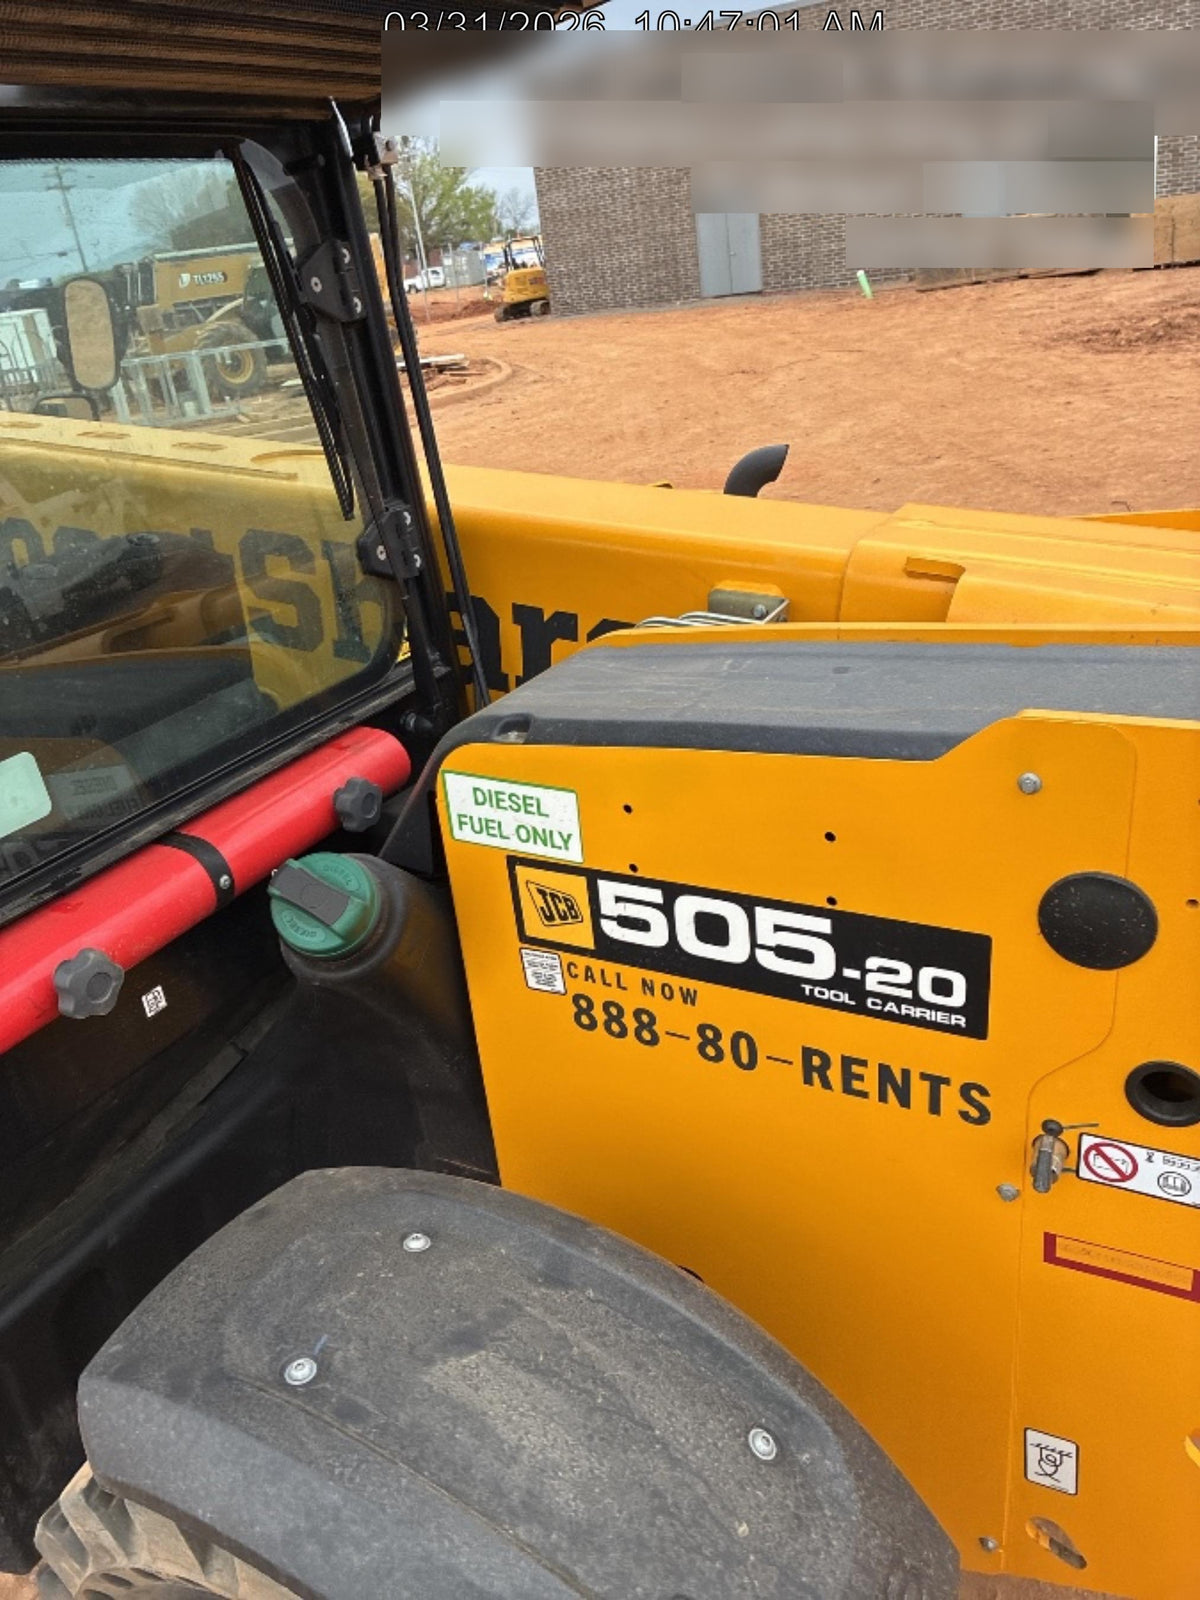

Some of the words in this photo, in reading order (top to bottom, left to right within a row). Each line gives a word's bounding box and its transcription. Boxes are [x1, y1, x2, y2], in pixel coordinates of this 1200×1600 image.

[472, 787, 550, 818] DIESEL
[457, 814, 511, 840] FUEL
[515, 824, 573, 851] ONLY
[535, 887, 579, 922] JCB
[596, 878, 967, 1008] 505-20
[566, 961, 628, 992] CALL
[641, 976, 698, 1007] NOW
[801, 983, 857, 1006] TOOL
[866, 996, 967, 1029] CARRIER
